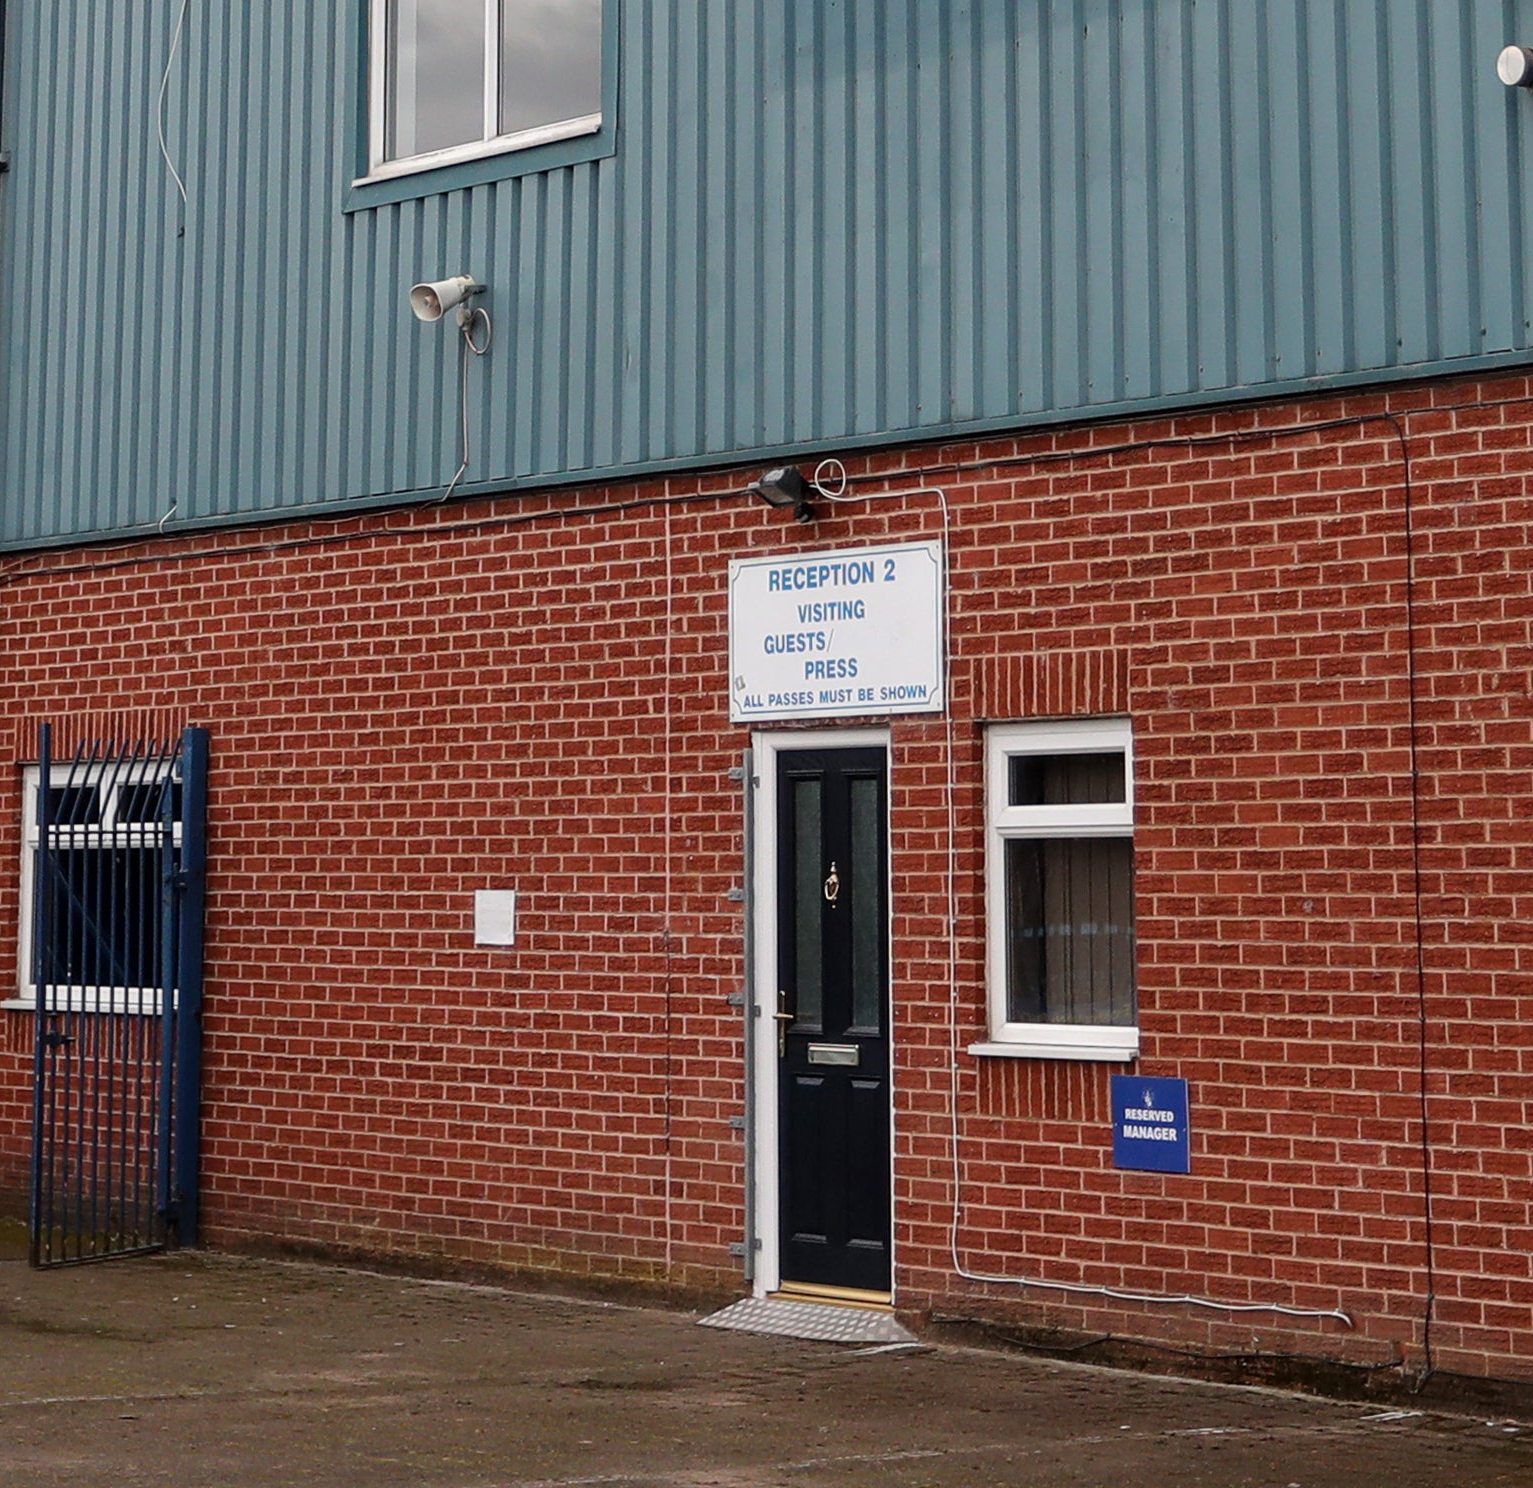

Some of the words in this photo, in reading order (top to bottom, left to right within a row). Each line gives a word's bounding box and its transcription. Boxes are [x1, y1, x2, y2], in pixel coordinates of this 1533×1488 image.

[768, 561, 875, 592] RECEPTION
[883, 559, 896, 582] 2
[798, 599, 865, 623] VISITING
[764, 628, 834, 655] GUESTS/
[805, 658, 858, 681] PRESS
[743, 694, 764, 709] ALL
[768, 691, 814, 707] PASSES
[819, 689, 853, 704] MUST
[858, 687, 875, 702] BE
[880, 685, 927, 700] SHOWN
[1124, 1108, 1175, 1123] RESERVED
[1122, 1124, 1178, 1142] MANAGER
